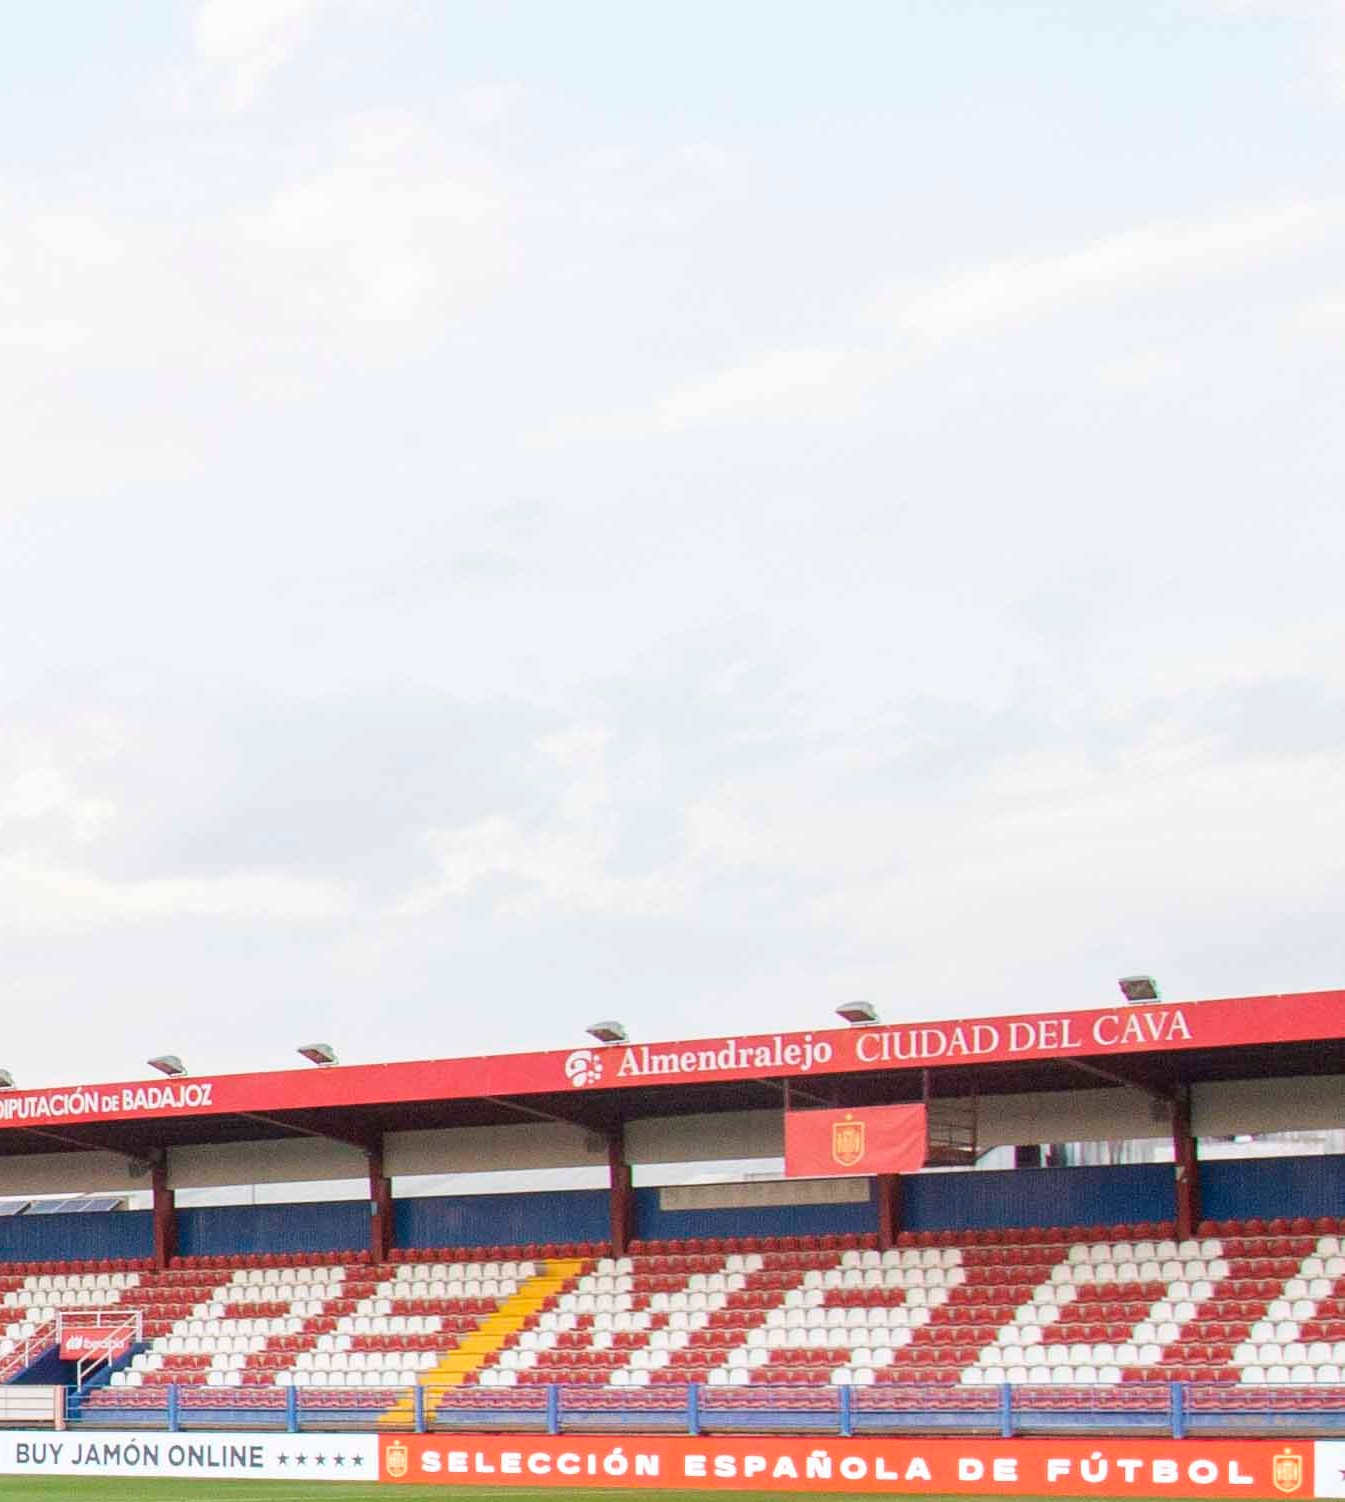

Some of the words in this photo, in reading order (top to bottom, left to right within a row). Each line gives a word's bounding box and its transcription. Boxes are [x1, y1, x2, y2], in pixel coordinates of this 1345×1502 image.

[618, 1034, 833, 1077] Almendralejo
[856, 1027, 1000, 1063] CIUDAD
[1008, 1018, 1081, 1051] DEL
[1092, 1010, 1193, 1046] CAVA
[101, 1095, 120, 1113] DE
[123, 1083, 213, 1112] BADAJOZ
[16, 1442, 62, 1465] BUY
[71, 1437, 157, 1467] JAMÓN
[168, 1444, 263, 1468] ONLINE
[421, 1447, 660, 1477] SELECCIÓN
[684, 1449, 931, 1482] ESPAÑOLA
[958, 1456, 1017, 1483] DE
[1047, 1450, 1254, 1485] FÚTBOL
